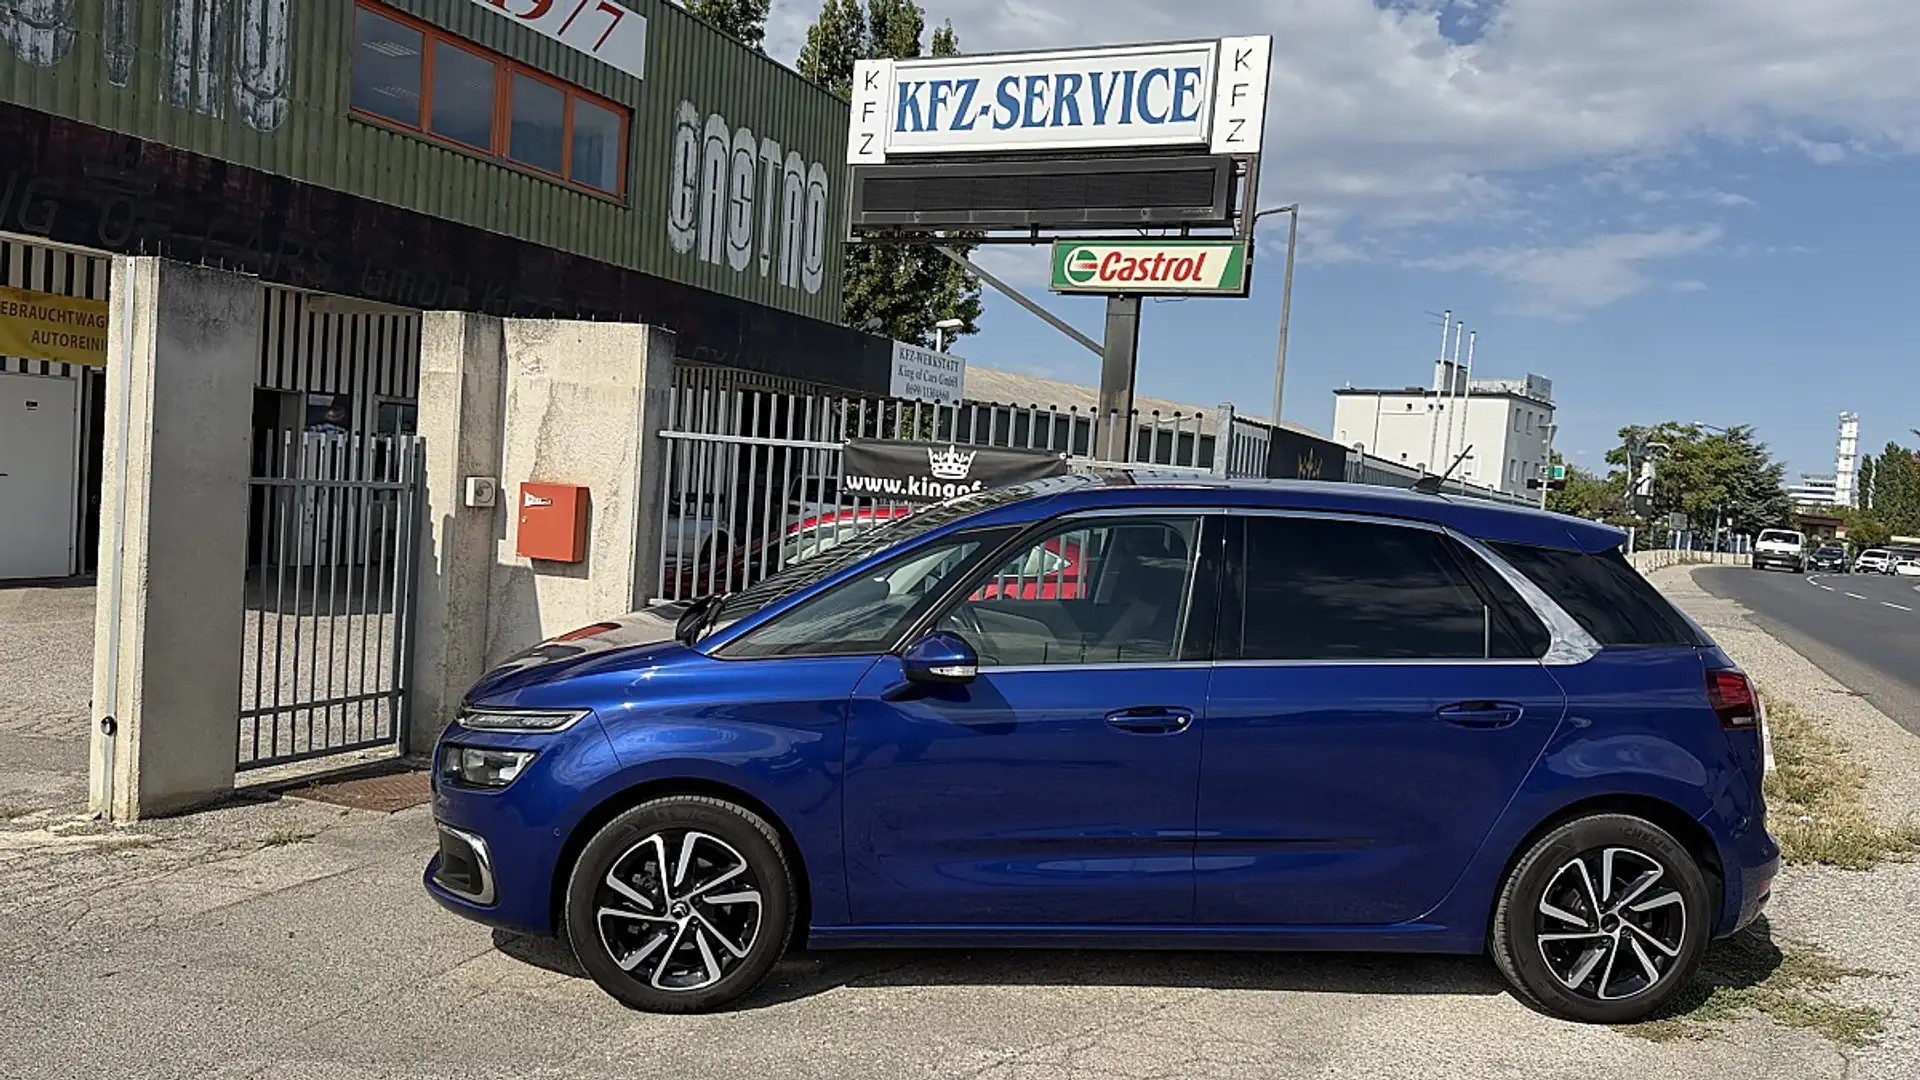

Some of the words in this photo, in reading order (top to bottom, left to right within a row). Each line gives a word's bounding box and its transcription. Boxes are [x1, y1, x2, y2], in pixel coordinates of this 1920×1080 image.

[895, 66, 1203, 132] KFZ-SERVICE
[1099, 251, 1207, 282] Castrol
[1, 301, 105, 328] EBRAUCHTWAG
[31, 329, 104, 352] AUTOREINI
[899, 347, 960, 372] KFZ-WERKSTATT
[898, 364, 914, 381] King
[915, 369, 923, 380] of
[923, 369, 938, 384] Cars
[938, 373, 958, 388] GmbH
